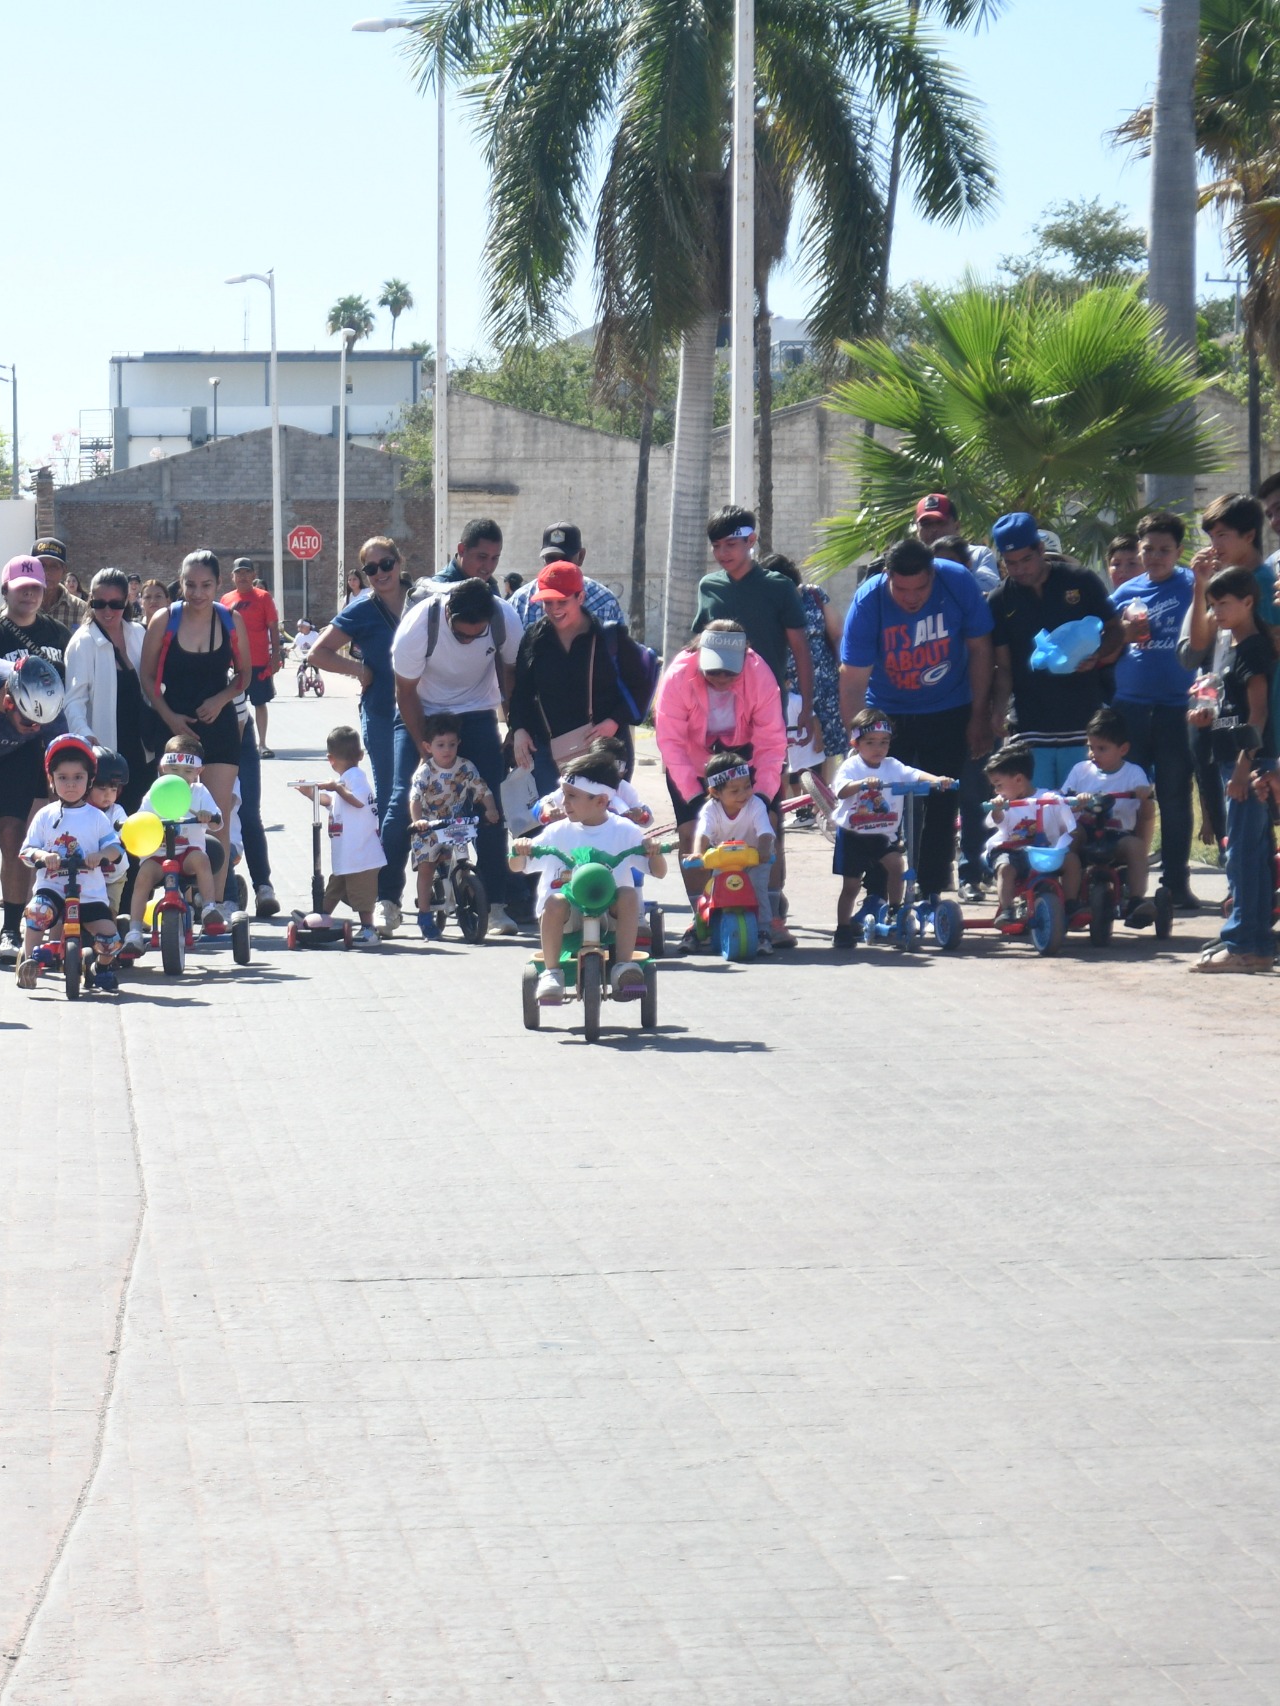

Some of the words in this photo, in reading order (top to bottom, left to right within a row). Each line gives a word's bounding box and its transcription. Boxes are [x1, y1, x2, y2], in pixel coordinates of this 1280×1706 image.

[291, 535, 319, 550] ALTO
[1147, 596, 1177, 620] odgers
[914, 612, 949, 647] ALL
[886, 637, 951, 671] ABOUT
